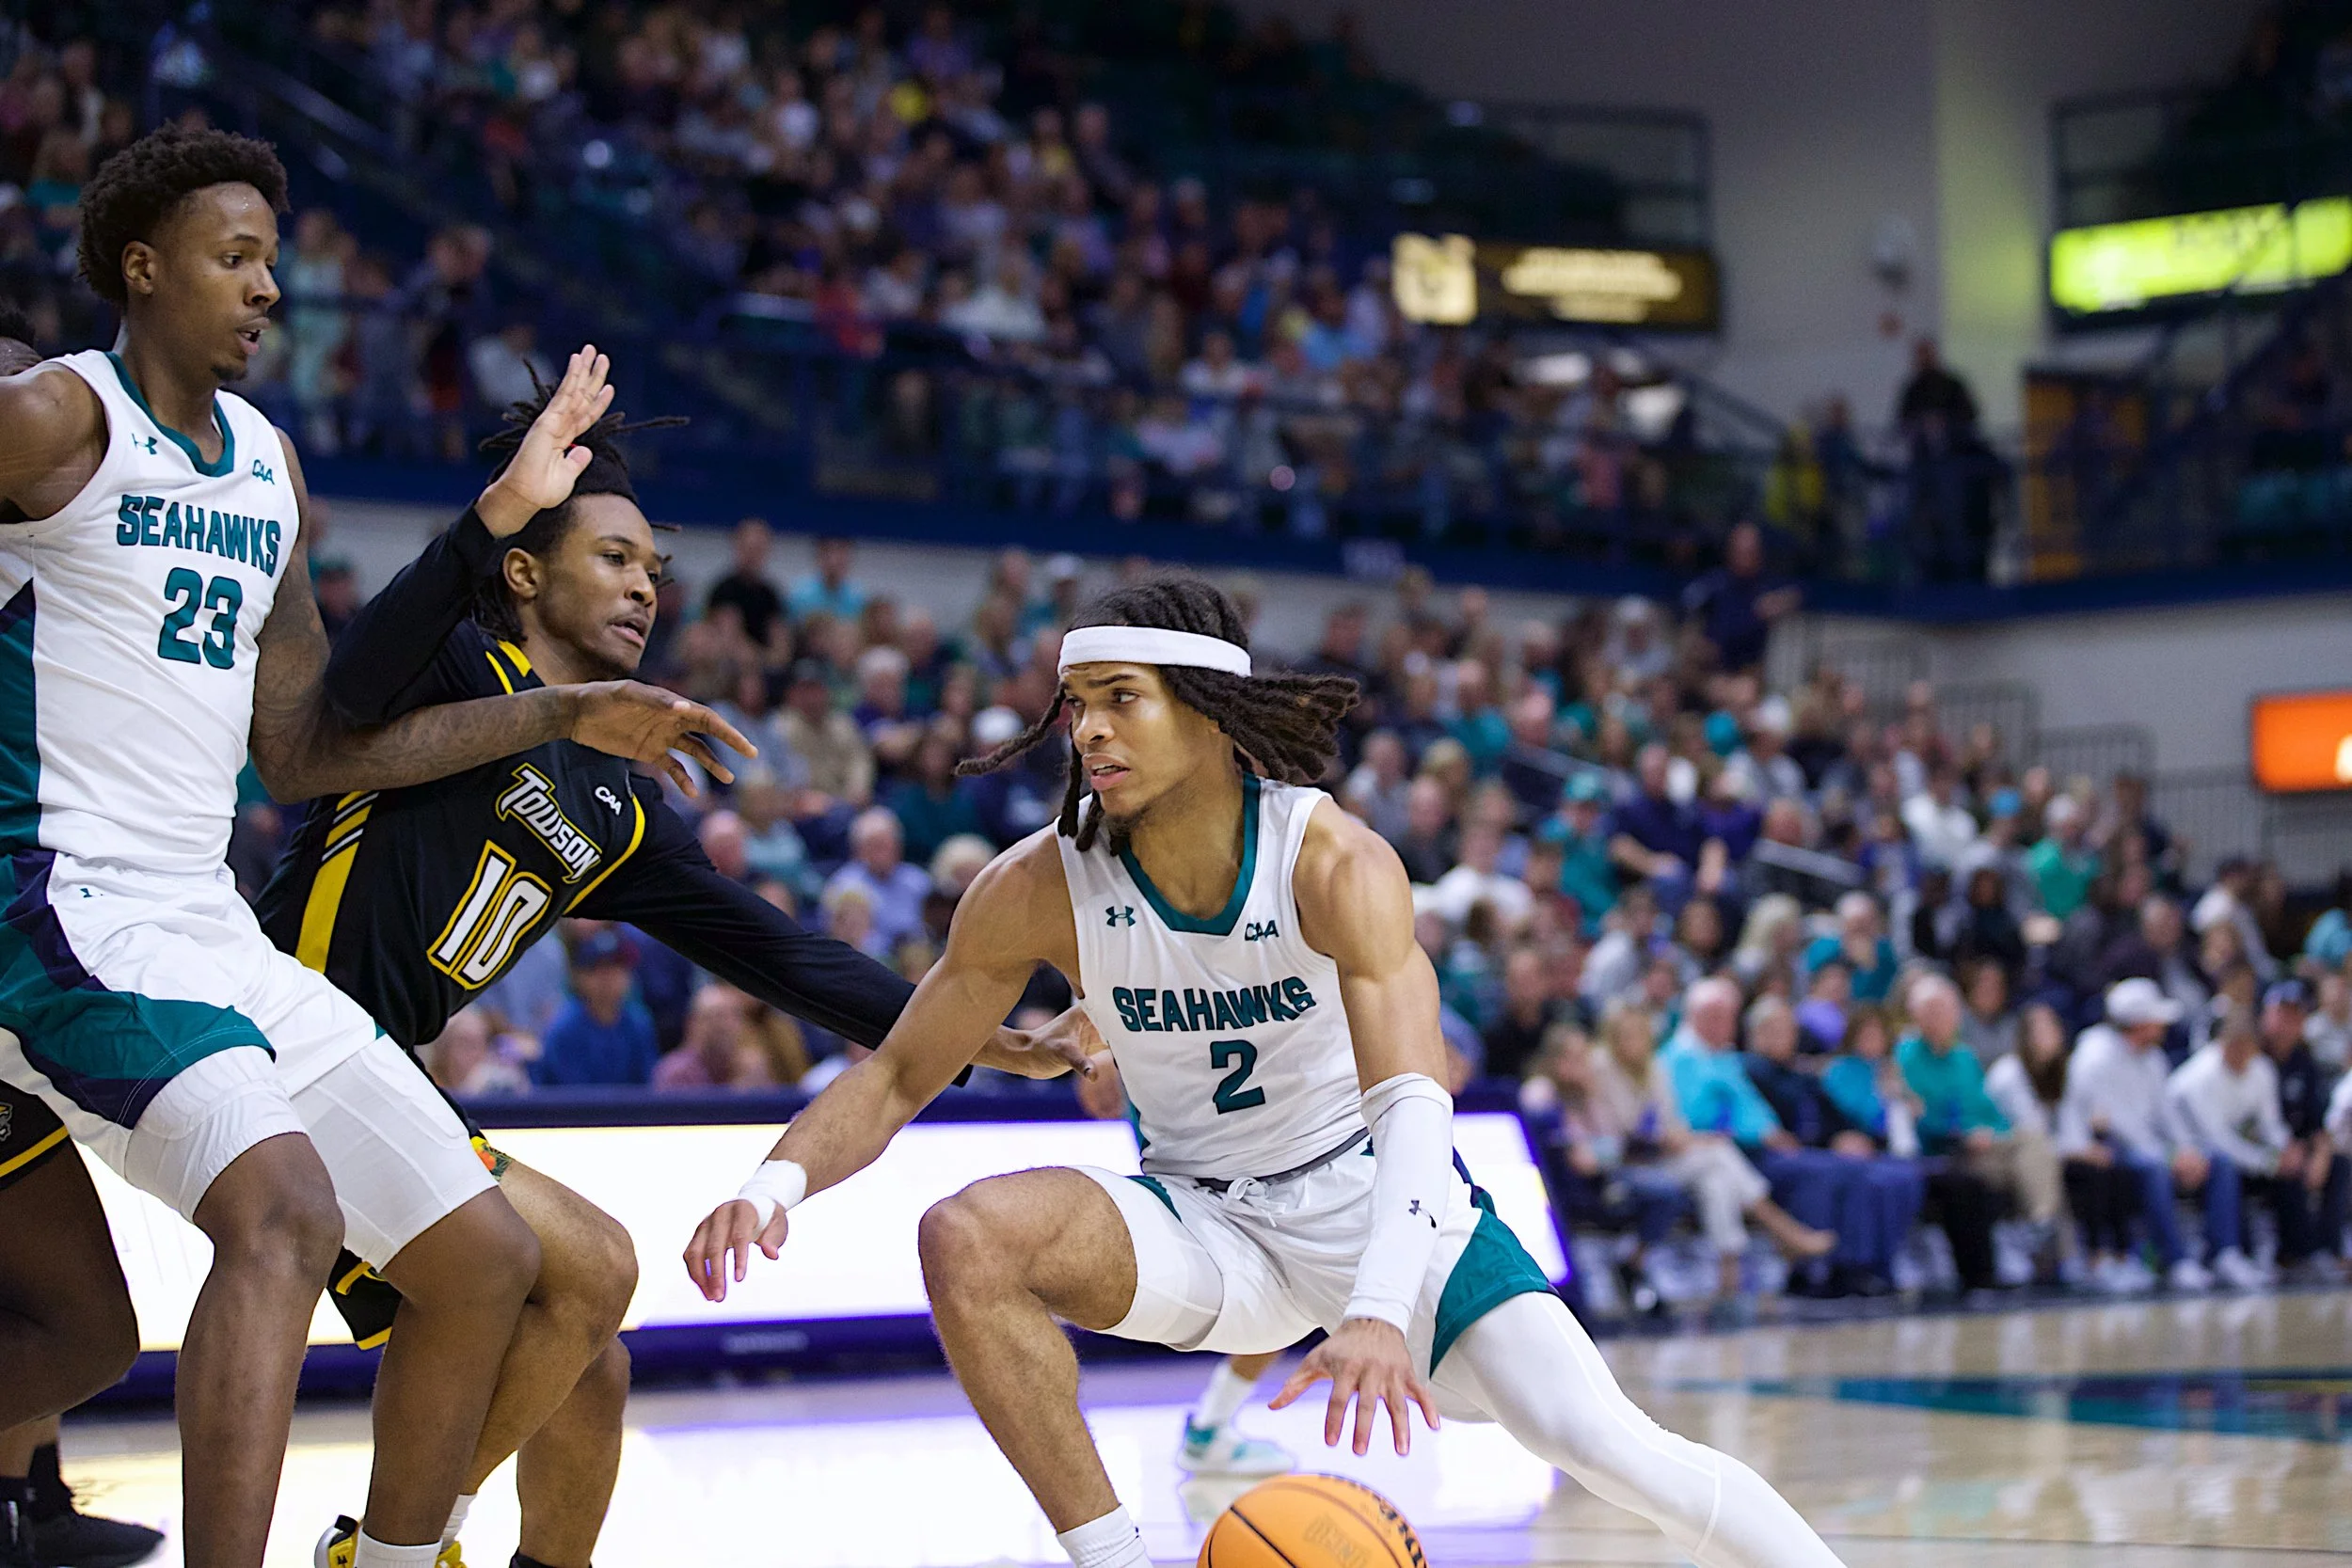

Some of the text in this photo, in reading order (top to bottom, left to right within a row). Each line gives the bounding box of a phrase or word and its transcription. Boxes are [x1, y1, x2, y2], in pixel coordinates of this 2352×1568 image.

[251, 458, 275, 484] CAA
[116, 494, 281, 578] SEAHAWKS
[157, 566, 243, 671] 23
[594, 786, 622, 816] CAA
[427, 840, 553, 990] 10
[1244, 919, 1279, 942] CAA
[1112, 975, 1317, 1033] SEAHAWKS
[1209, 1038, 1266, 1116] 2
